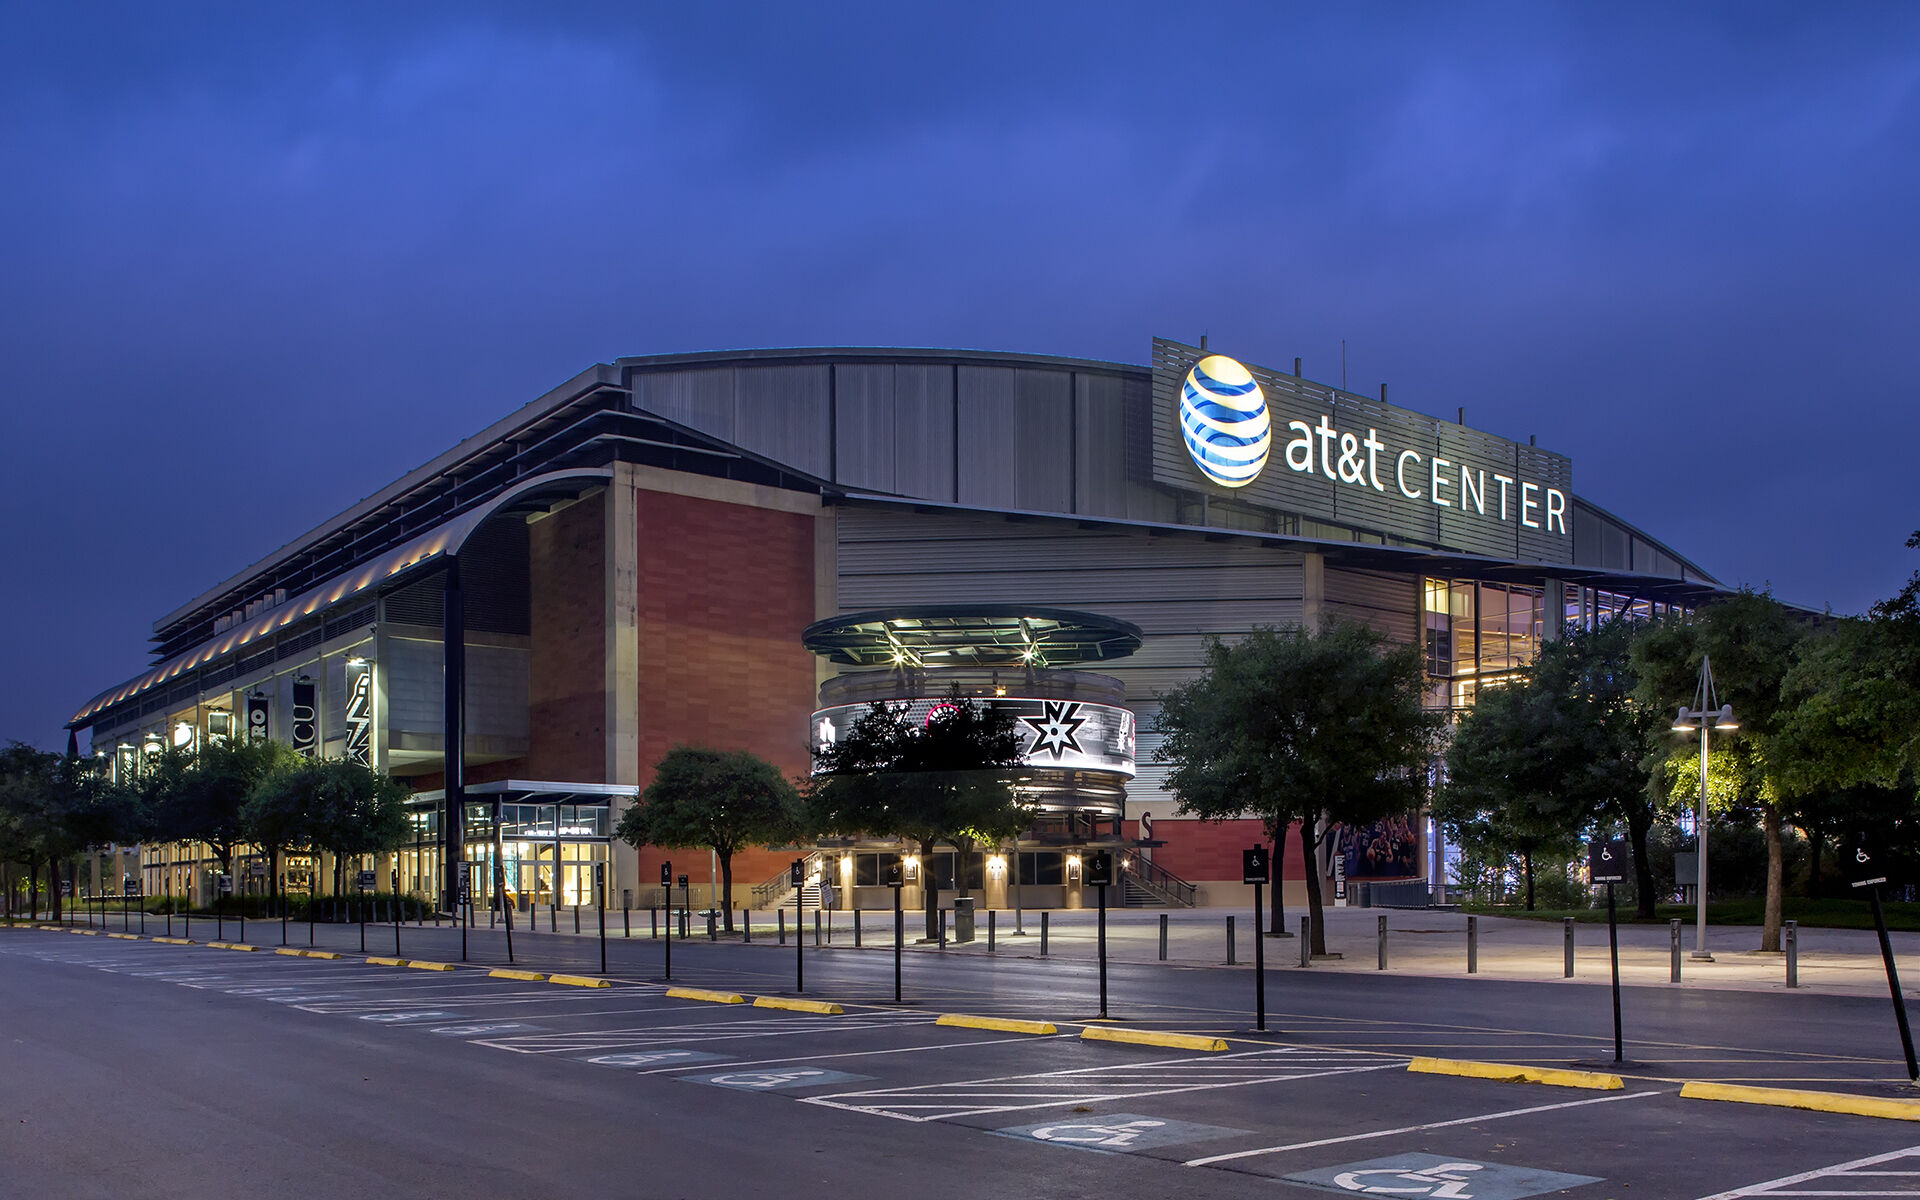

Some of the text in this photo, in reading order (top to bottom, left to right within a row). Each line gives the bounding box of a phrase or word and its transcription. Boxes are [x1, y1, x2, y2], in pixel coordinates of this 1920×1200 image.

[1285, 415, 1567, 535] at&t CENTER
[251, 709, 266, 747] RO
